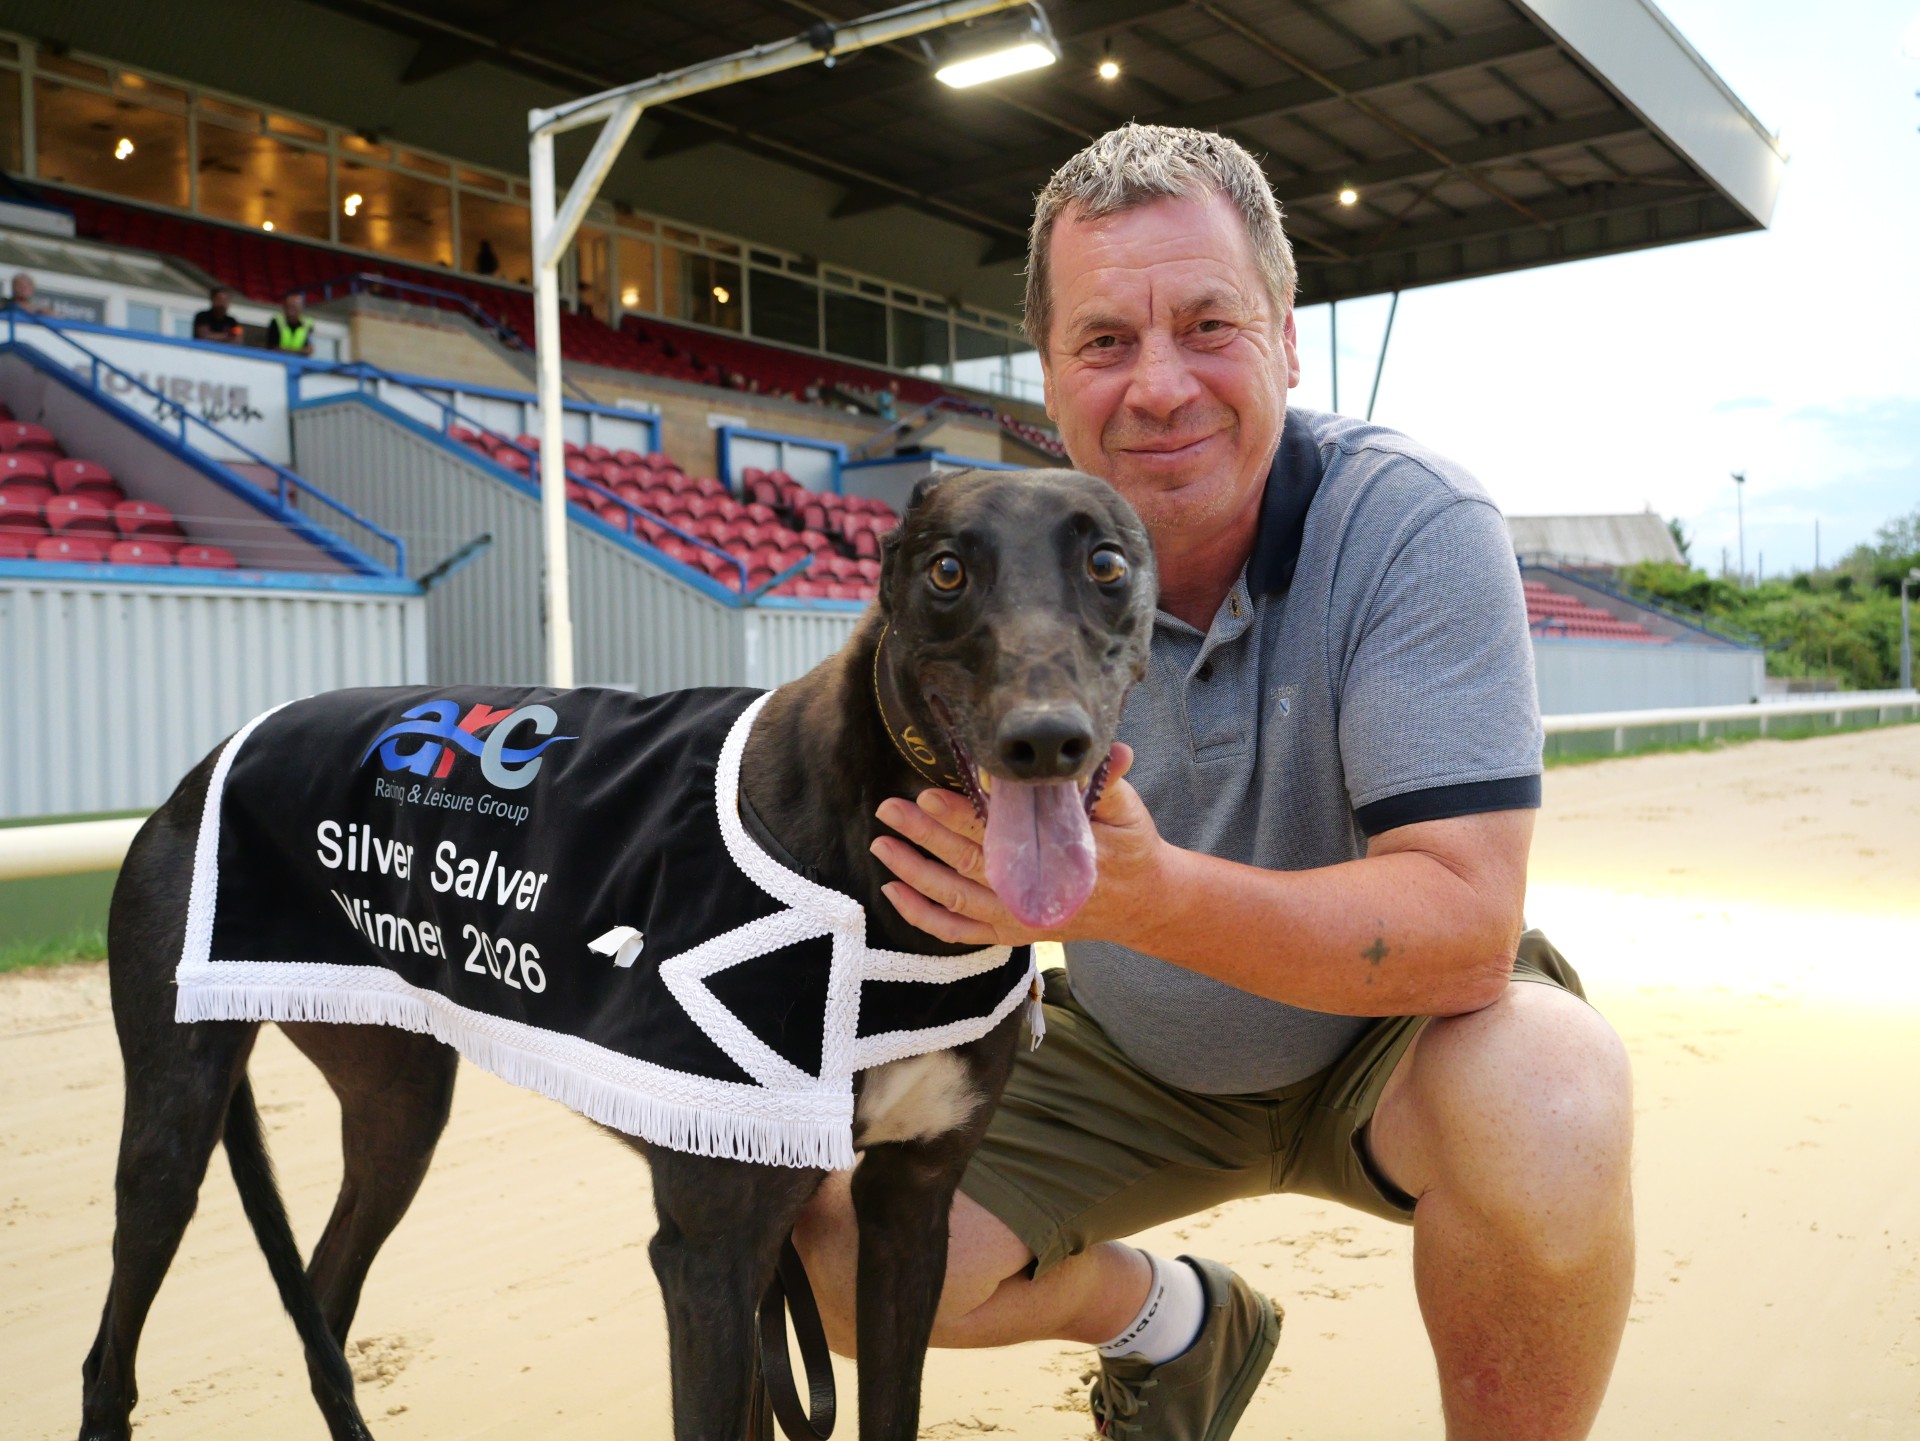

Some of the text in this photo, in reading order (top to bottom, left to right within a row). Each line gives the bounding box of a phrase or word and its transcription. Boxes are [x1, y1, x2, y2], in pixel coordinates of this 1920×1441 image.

[361, 700, 578, 789] arc
[375, 778, 529, 826] Racing & Leisure Group
[317, 820, 548, 912] Silver Salver
[462, 924, 547, 993] 2026
